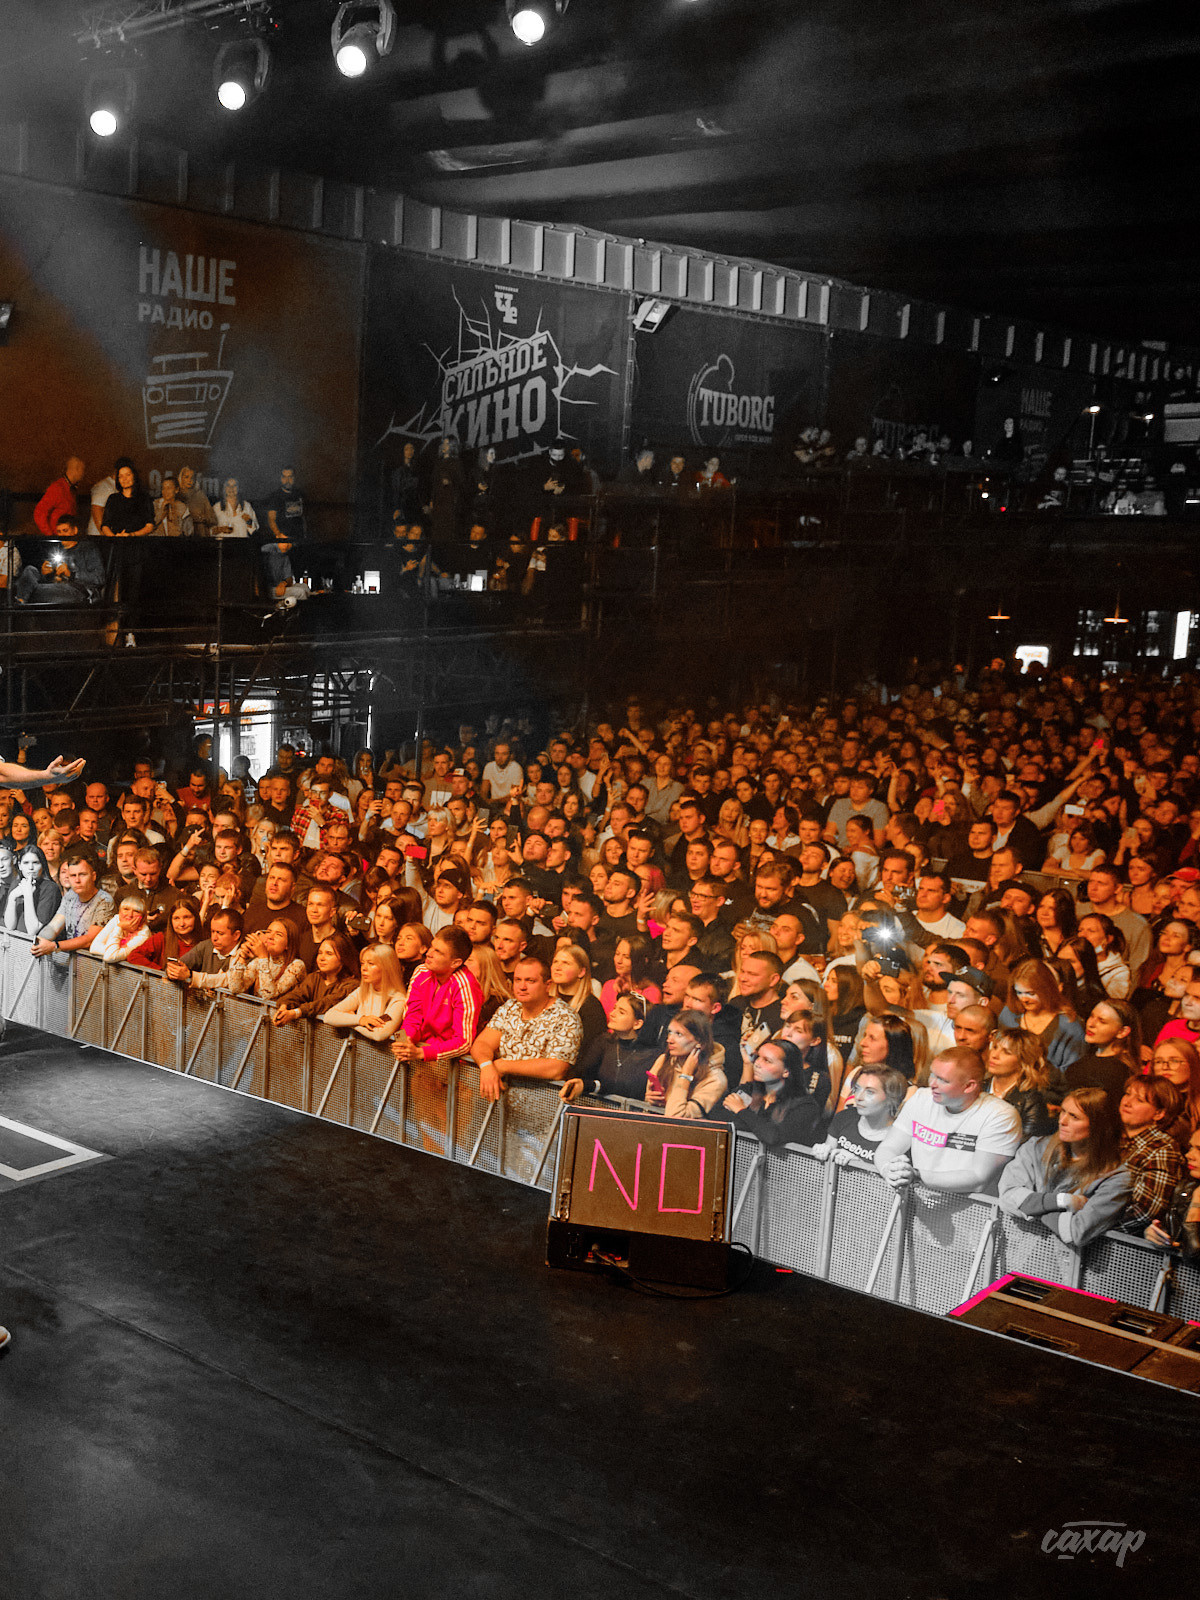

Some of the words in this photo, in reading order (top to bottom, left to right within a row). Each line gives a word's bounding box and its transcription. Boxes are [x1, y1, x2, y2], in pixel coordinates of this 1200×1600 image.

[140, 246, 237, 306] НАШЕ
[139, 302, 214, 331] РАДИО
[444, 336, 548, 405] СИЛЬНОЕ
[442, 375, 547, 449] КИНО
[700, 387, 775, 433] TUBORG
[837, 1135, 876, 1161] Reebok
